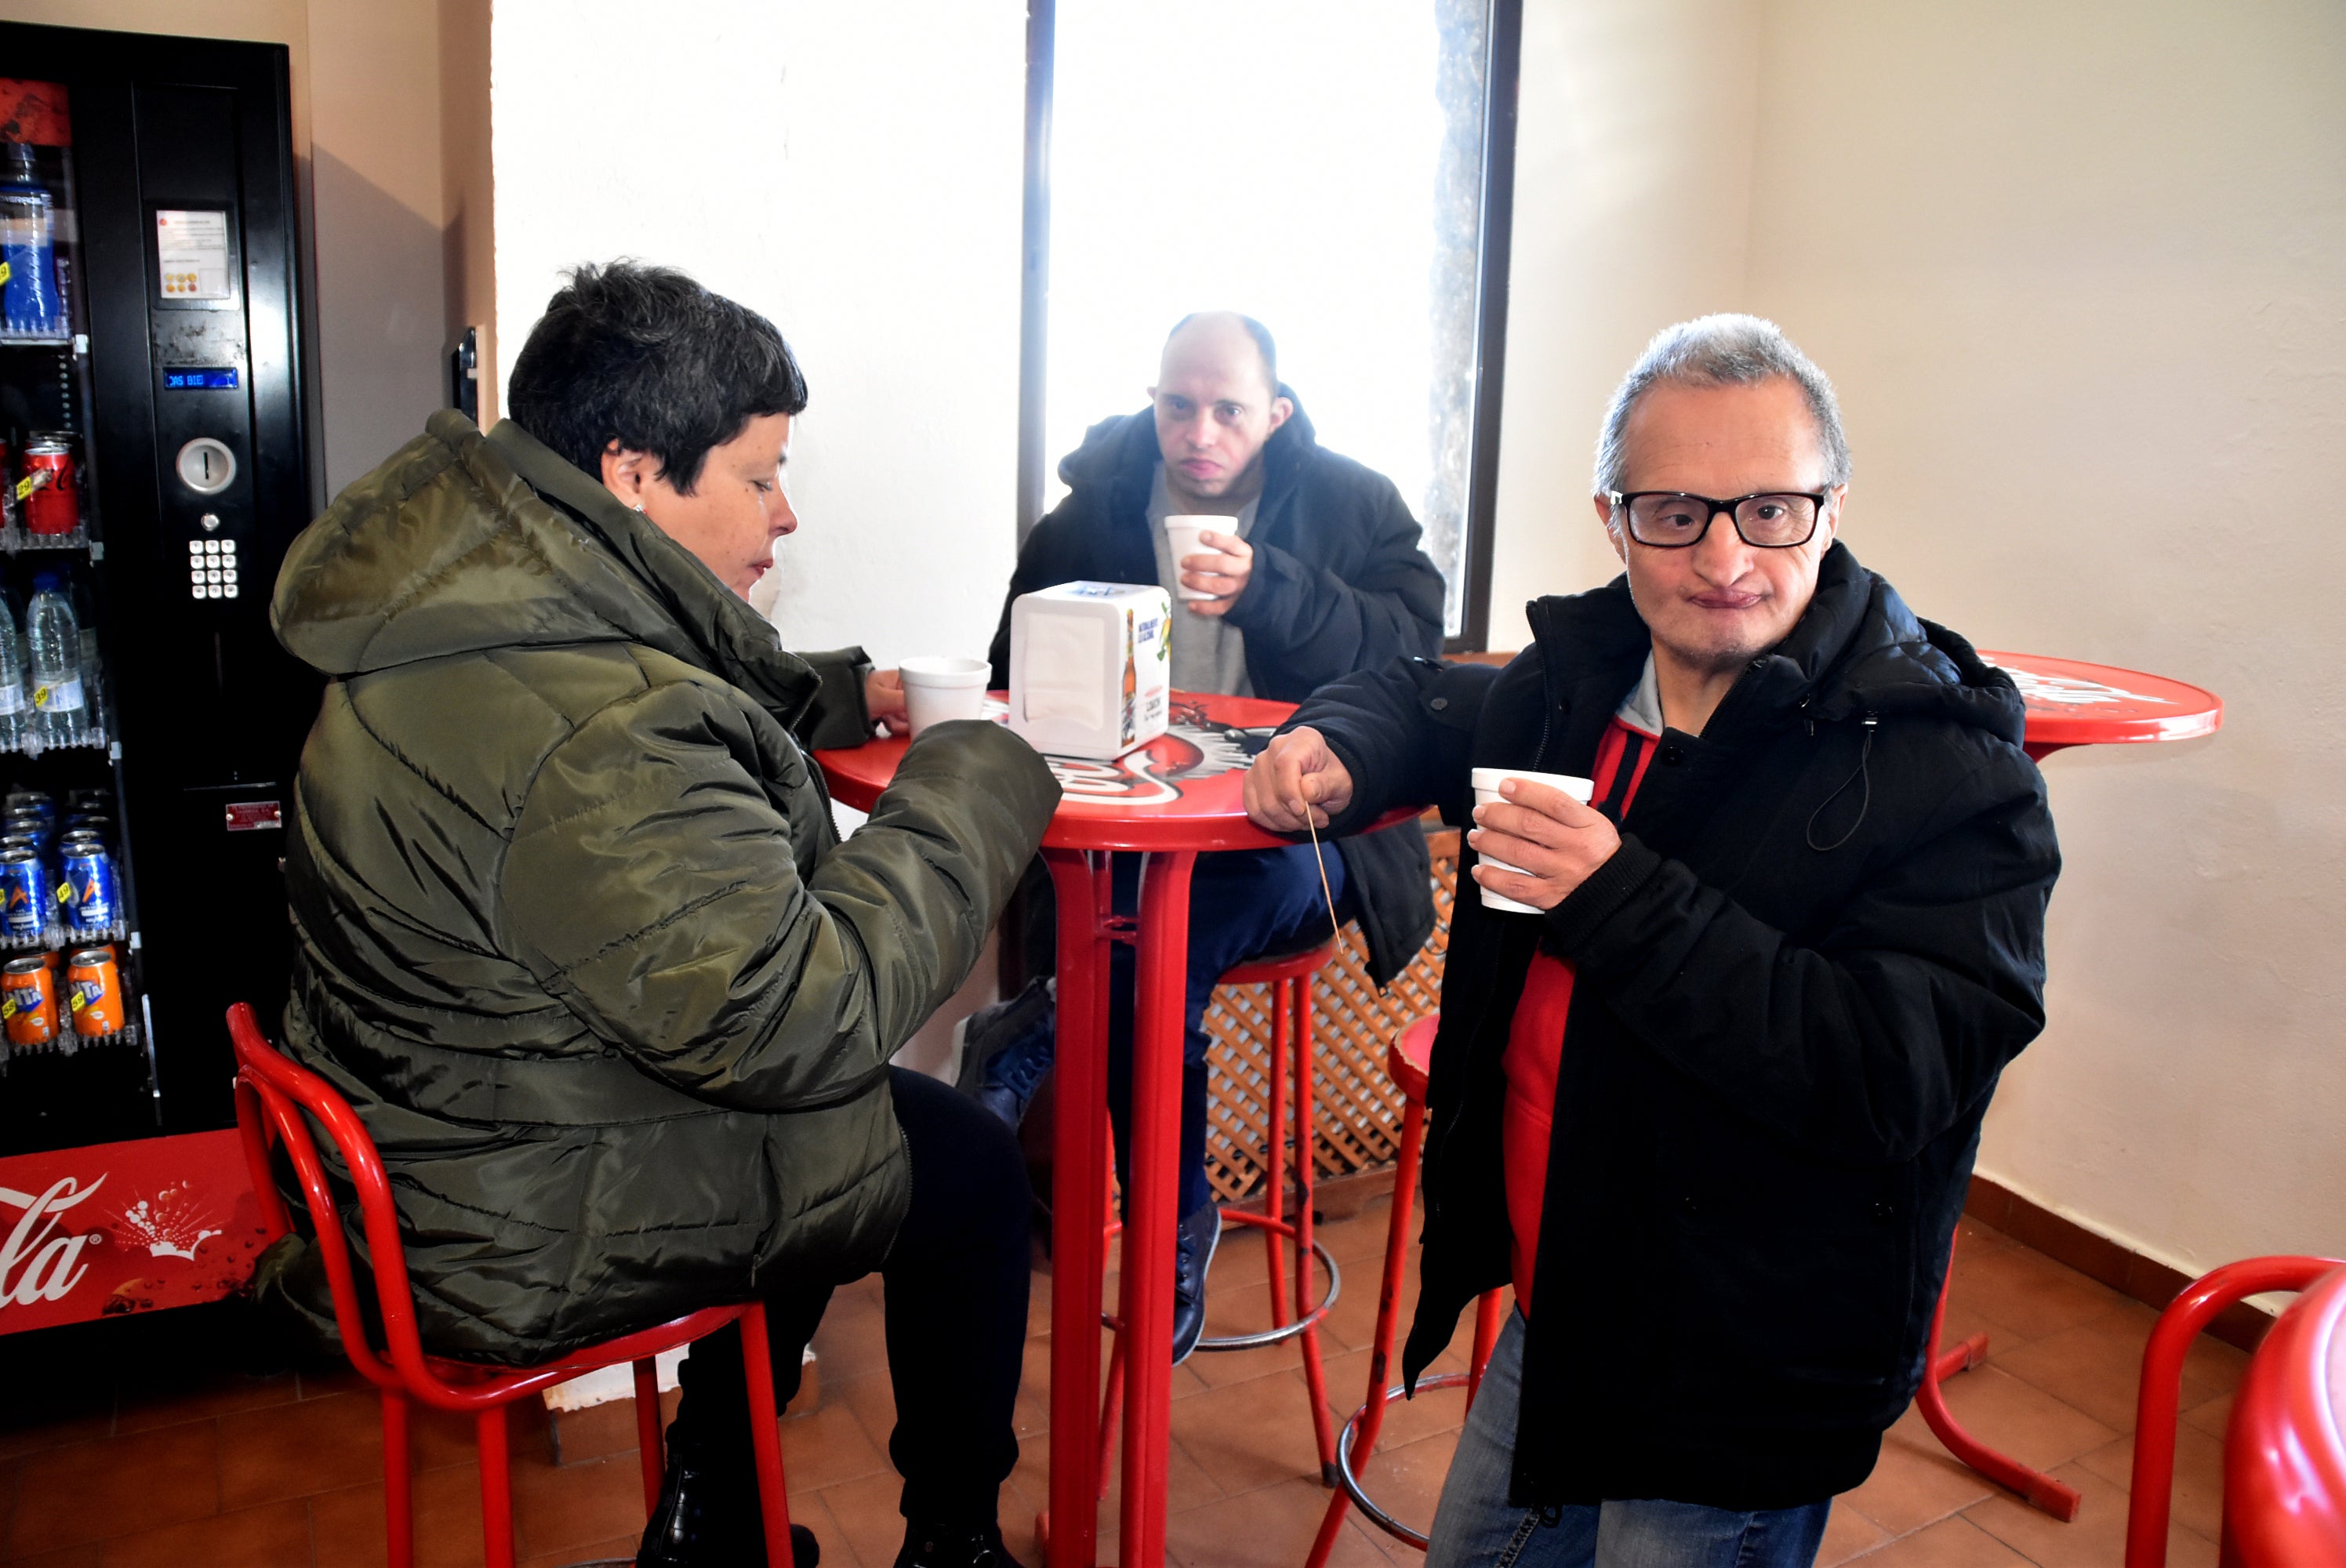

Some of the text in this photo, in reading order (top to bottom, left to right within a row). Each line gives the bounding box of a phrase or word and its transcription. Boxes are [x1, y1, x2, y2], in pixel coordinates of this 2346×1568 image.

[18, 481, 30, 495] 29
[35, 688, 46, 703] 39
[3, 1000, 15, 1017] 58
[72, 994, 83, 1009] 59
